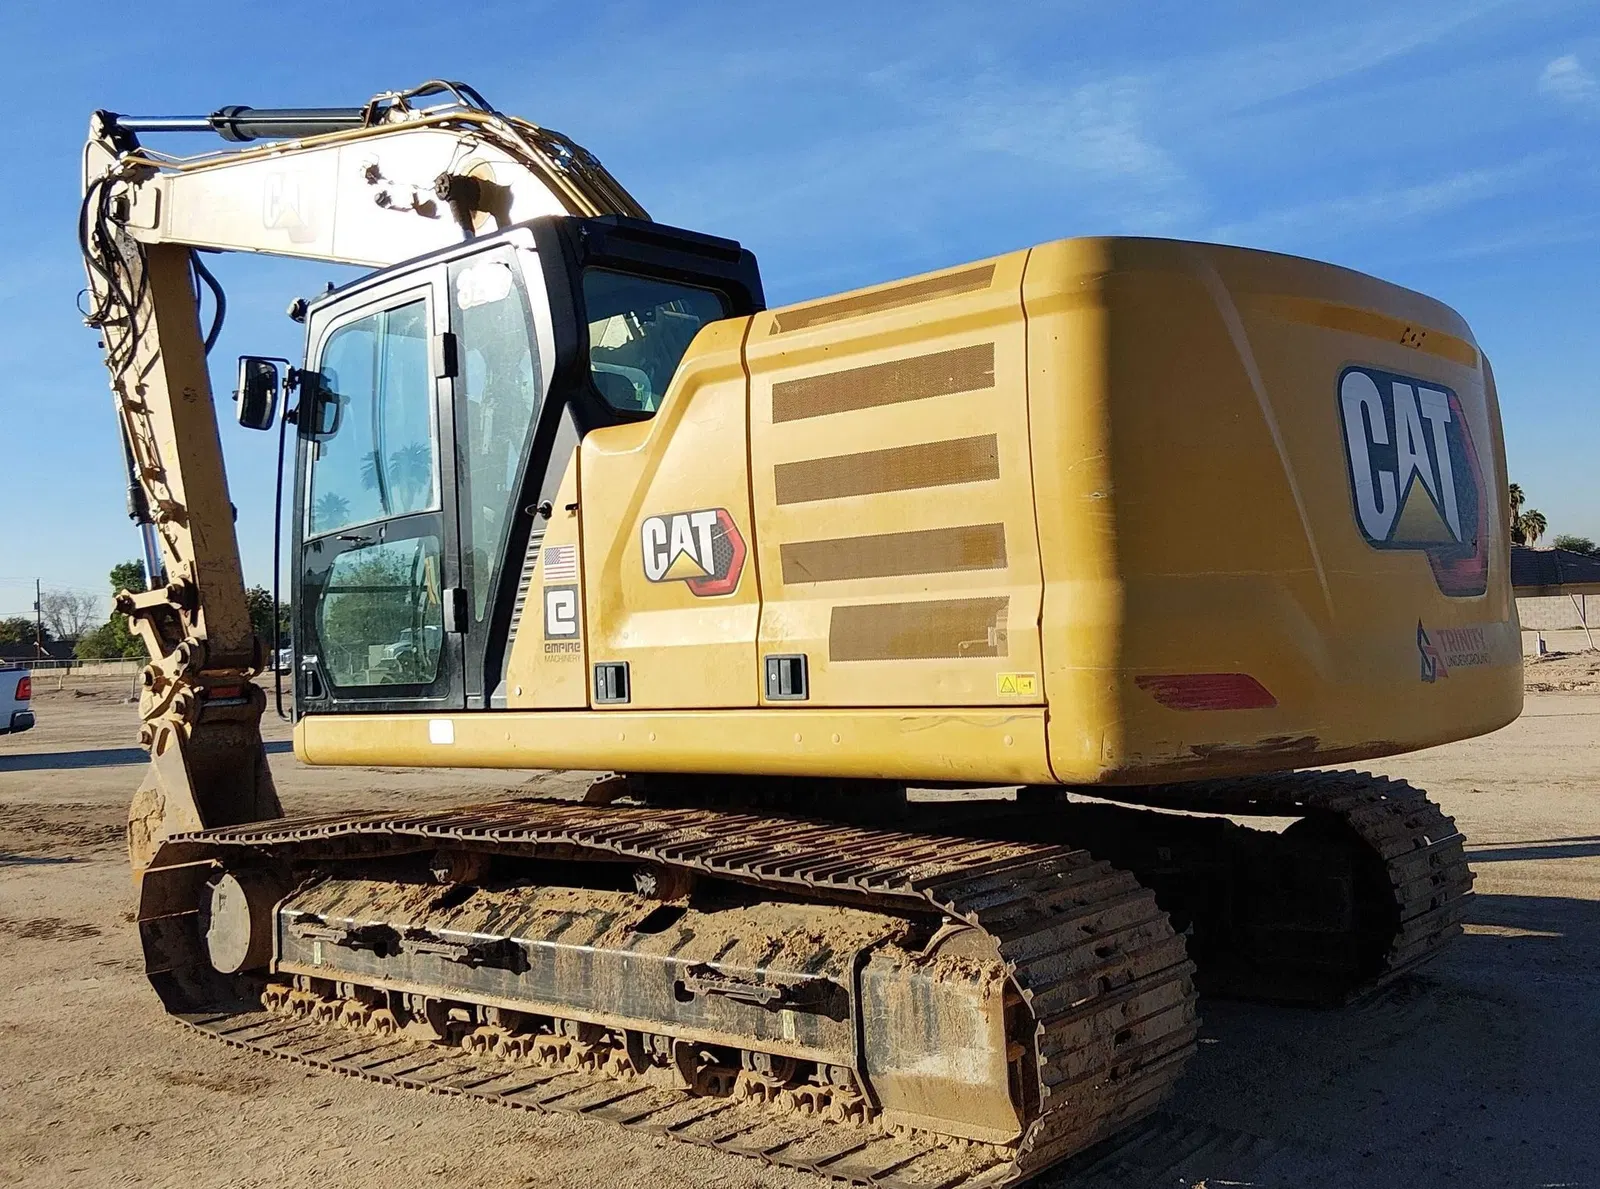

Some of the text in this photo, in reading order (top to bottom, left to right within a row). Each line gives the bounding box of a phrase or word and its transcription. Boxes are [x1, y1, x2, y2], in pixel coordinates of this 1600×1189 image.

[1341, 371, 1462, 542] CAT
[642, 510, 717, 580] CAT
[544, 654, 580, 663] MACHINERY
[1436, 628, 1486, 652] TRINITY
